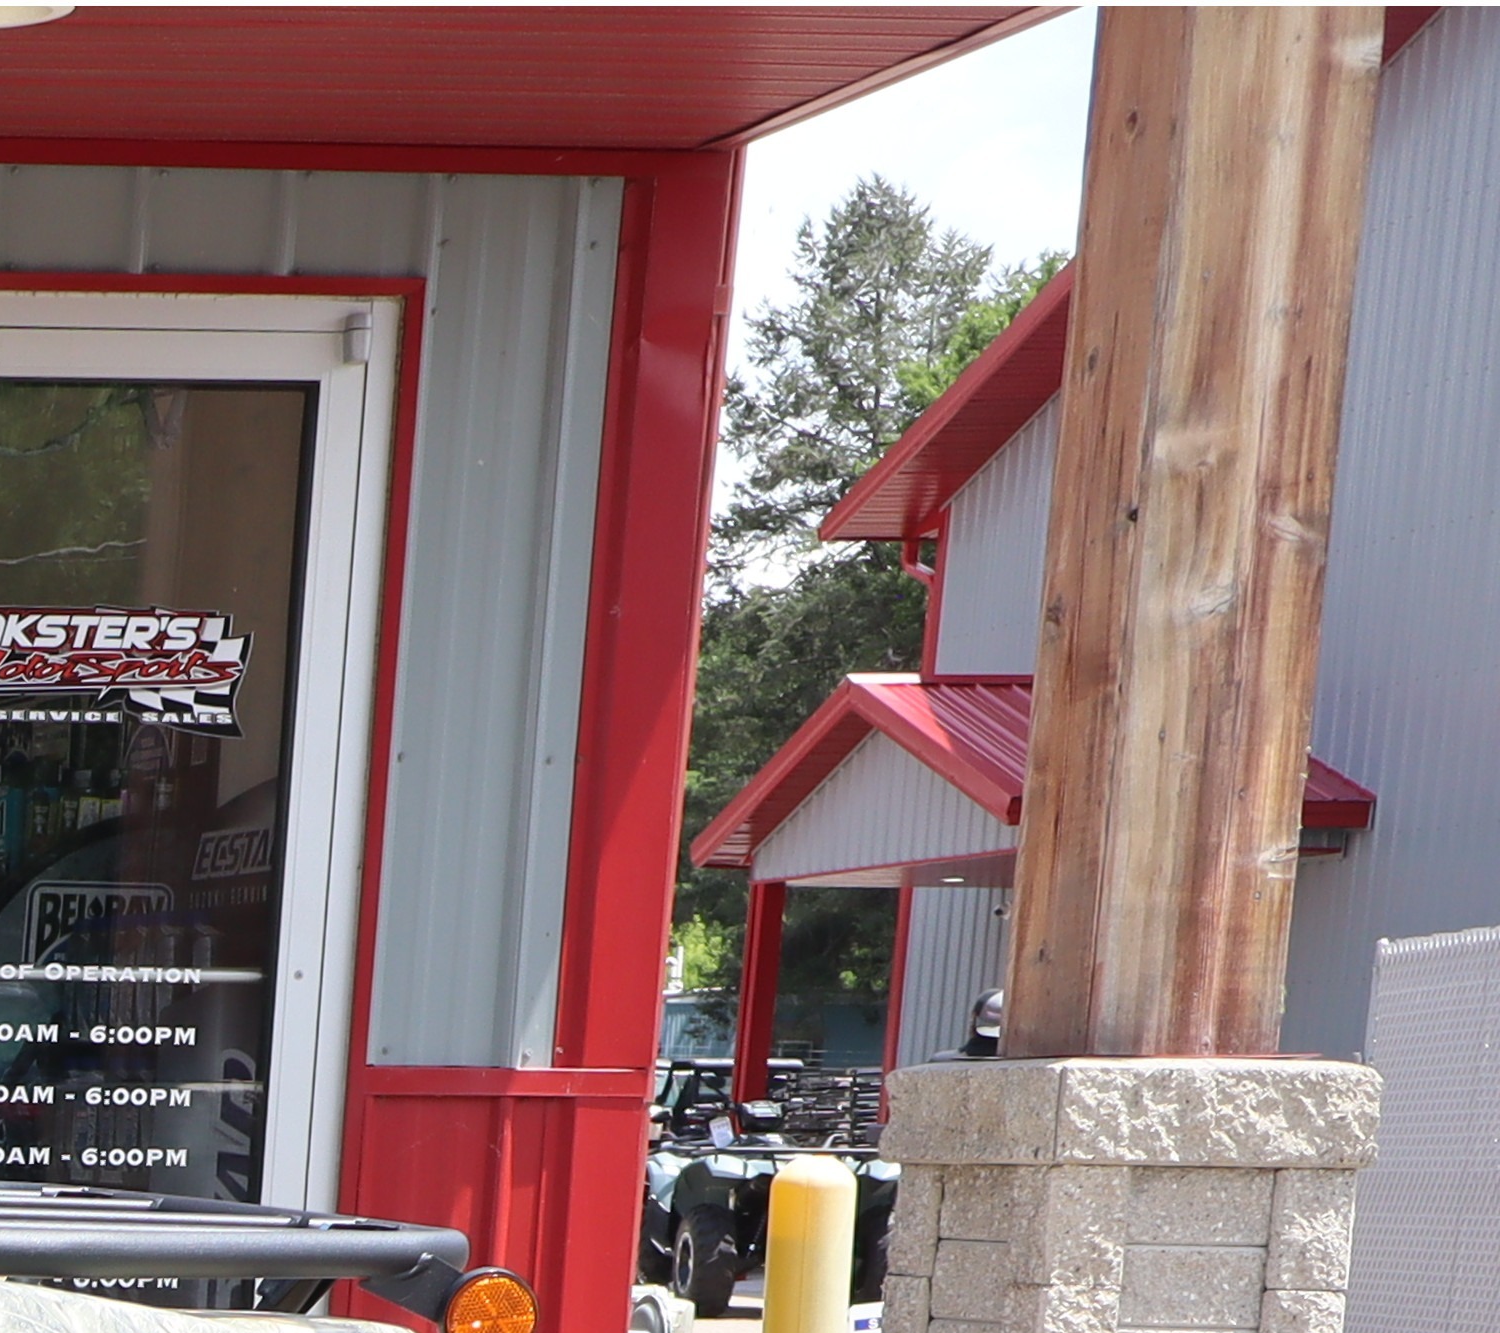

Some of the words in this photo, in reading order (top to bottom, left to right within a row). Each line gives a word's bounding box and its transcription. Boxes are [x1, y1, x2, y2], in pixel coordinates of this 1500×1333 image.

[141, 711, 234, 725] SALES
[89, 1025, 197, 1046] 6:00PM
[85, 1086, 192, 1108] 6:00PM
[81, 1147, 188, 1168] 6:00PM
